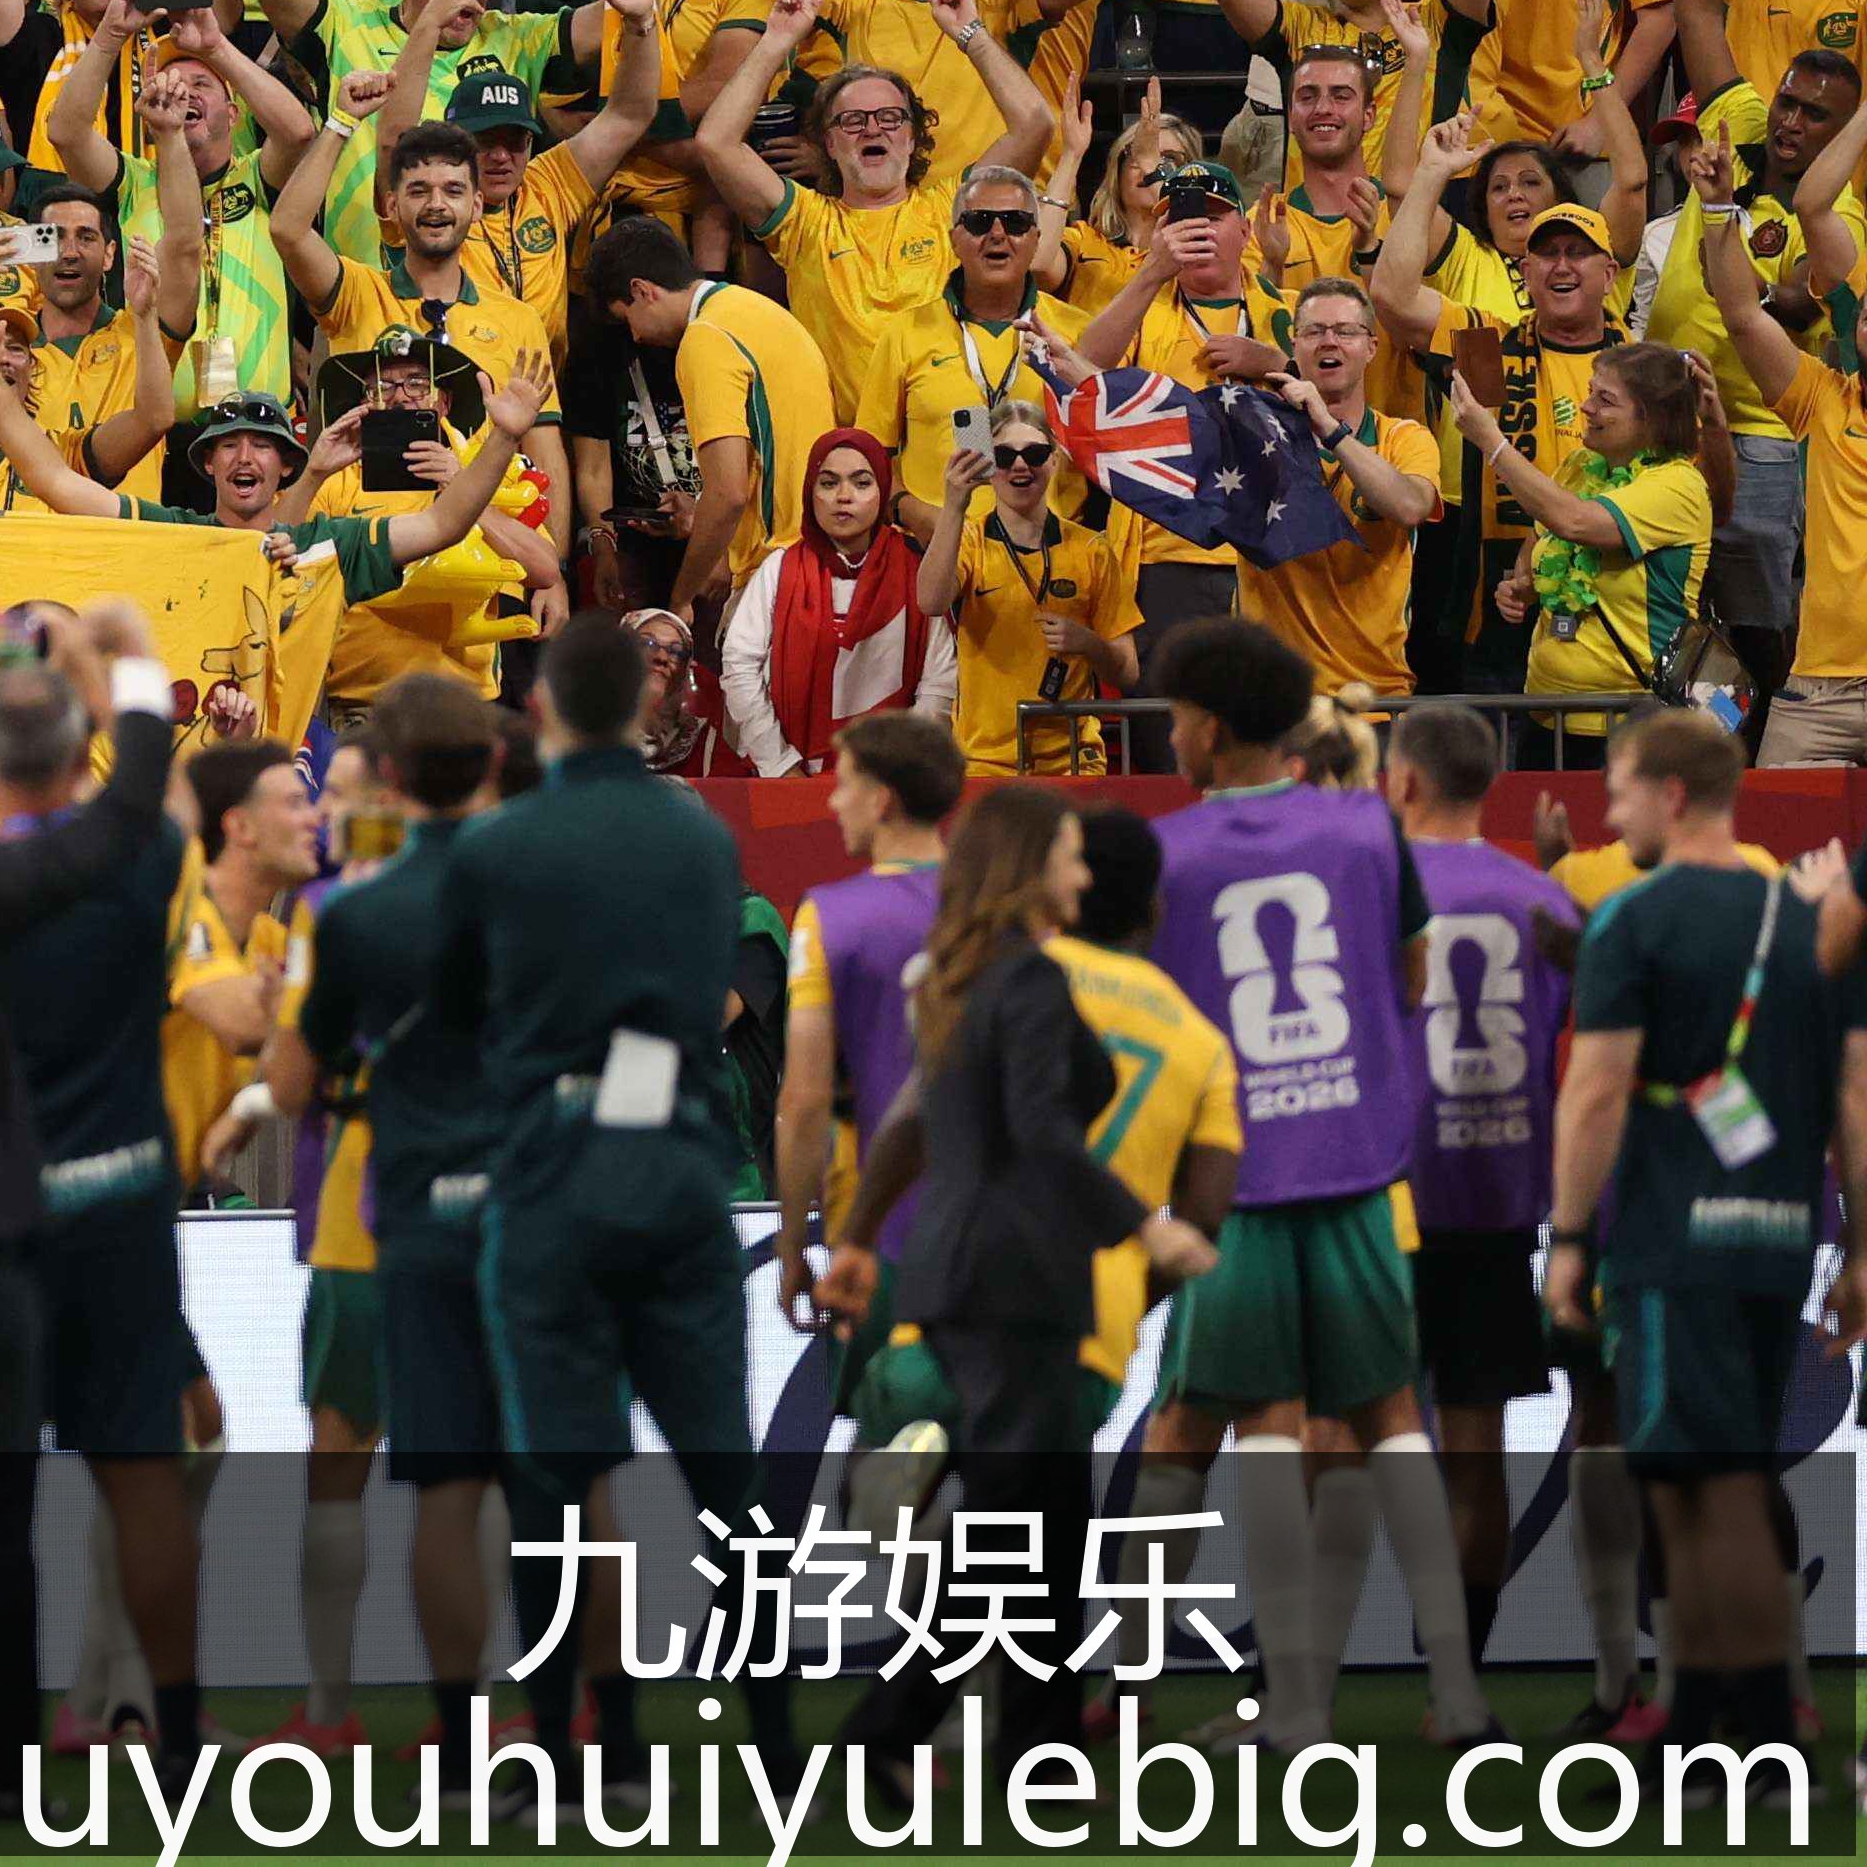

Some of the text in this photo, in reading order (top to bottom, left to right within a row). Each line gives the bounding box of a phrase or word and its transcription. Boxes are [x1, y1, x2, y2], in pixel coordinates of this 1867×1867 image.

[481, 85, 519, 106] AUS
[1268, 1019, 1322, 1045] FIFA
[1246, 1078, 1361, 1121] 2026
